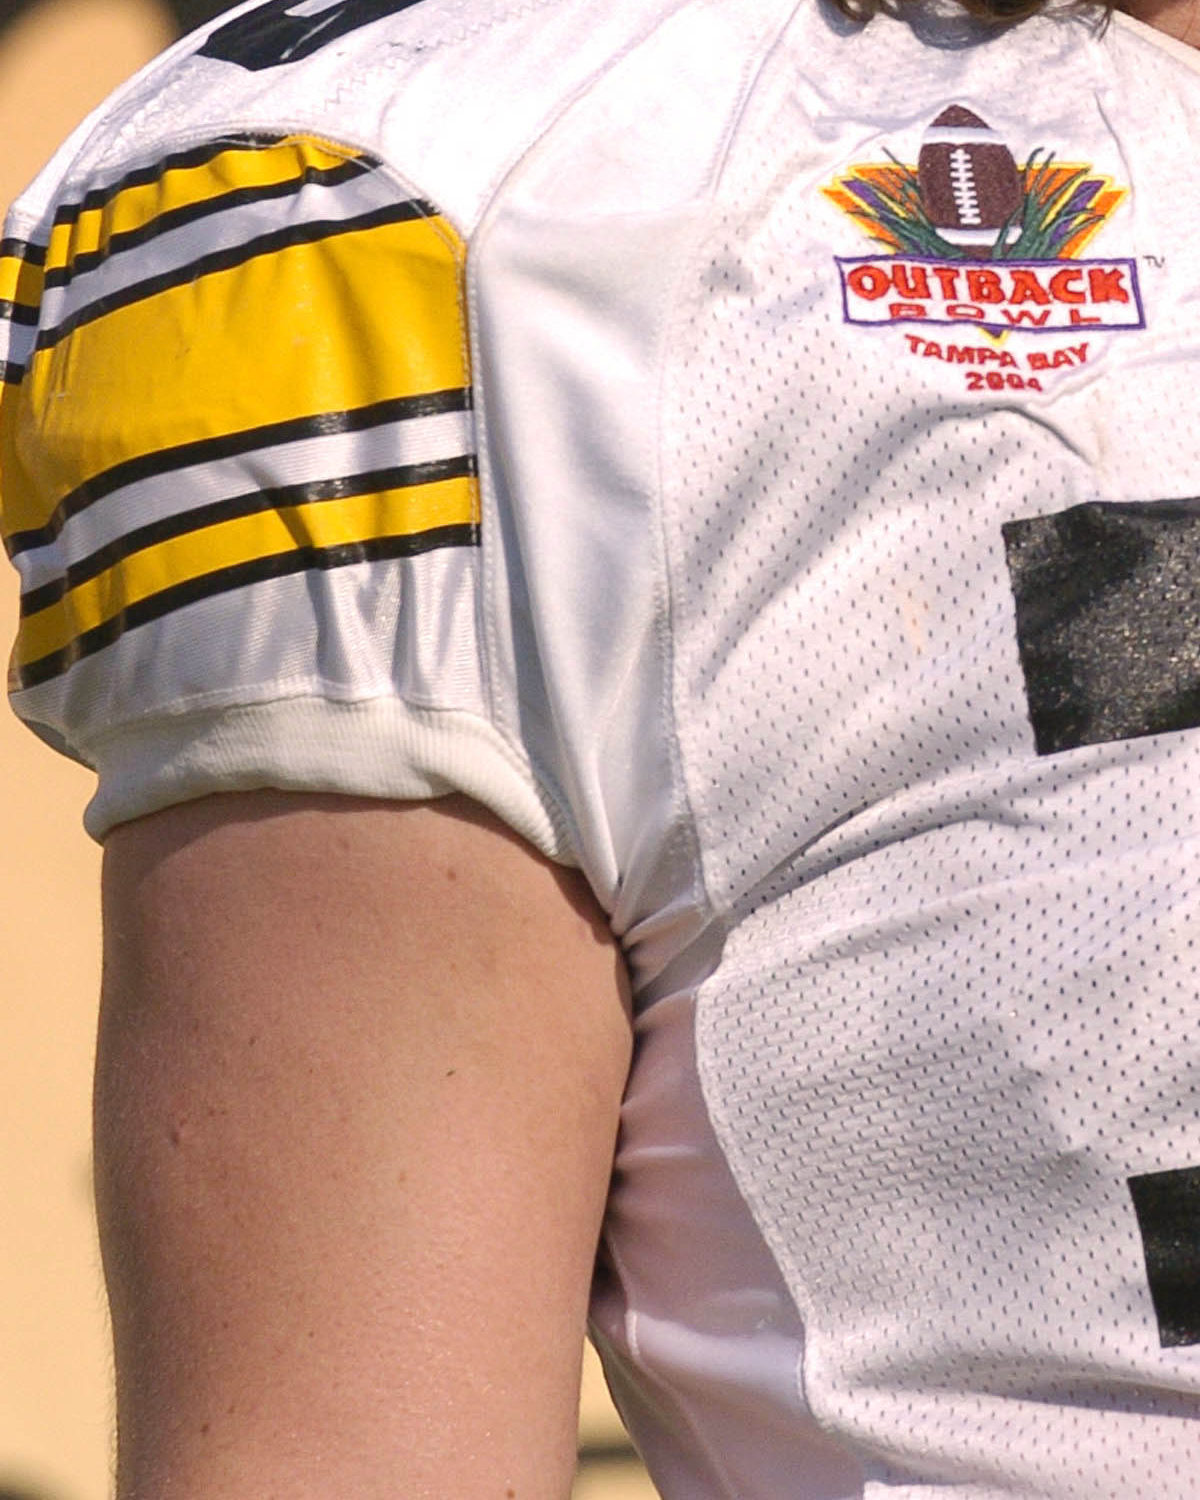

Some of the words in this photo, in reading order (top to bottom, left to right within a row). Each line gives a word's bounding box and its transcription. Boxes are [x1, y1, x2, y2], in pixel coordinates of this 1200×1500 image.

[847, 264, 1130, 304] OUTBACK
[889, 303, 1101, 325] BOWL
[905, 334, 1019, 369] TAMPA
[1026, 342, 1089, 370] BAY
[965, 371, 1043, 392] 2004
